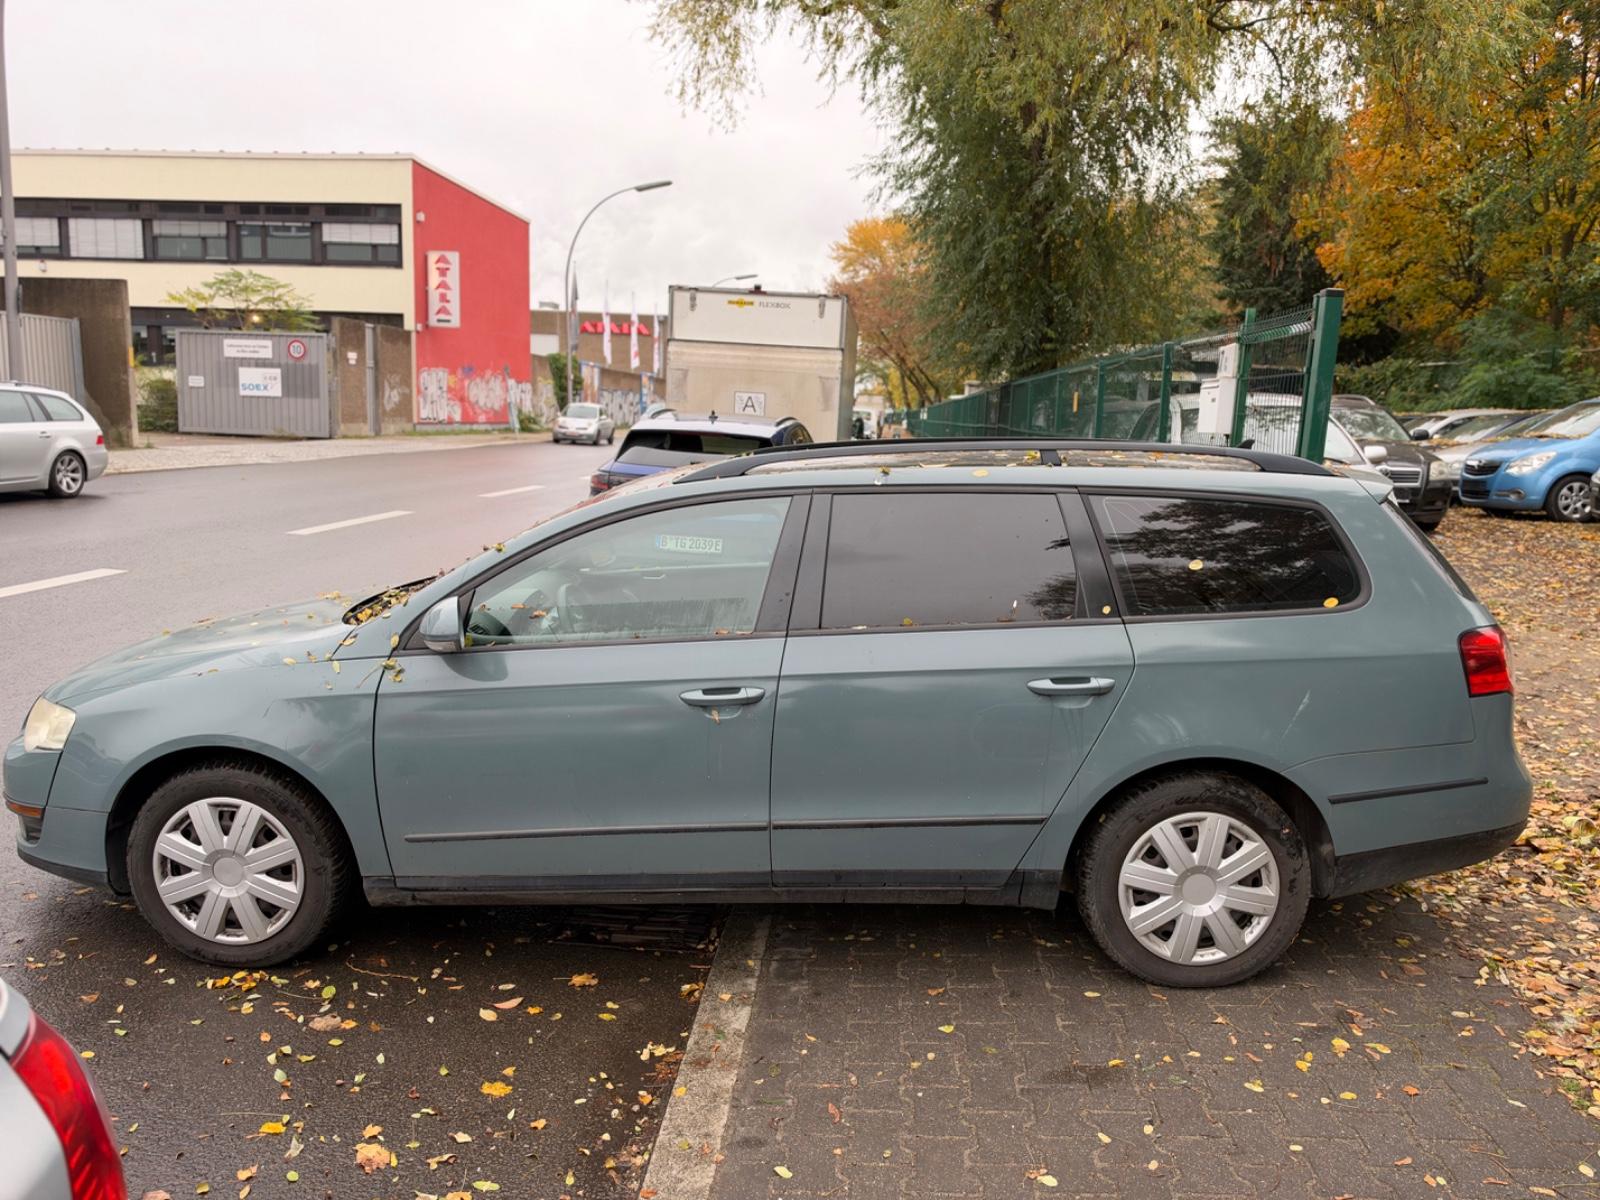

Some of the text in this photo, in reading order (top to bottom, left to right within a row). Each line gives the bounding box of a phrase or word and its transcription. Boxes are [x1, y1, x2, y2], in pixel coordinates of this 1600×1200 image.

[434, 253, 452, 316] ATALA
[291, 344, 302, 355] 10
[240, 383, 268, 392] SOEX
[742, 395, 757, 413] A
[688, 538, 721, 552] 2039E
